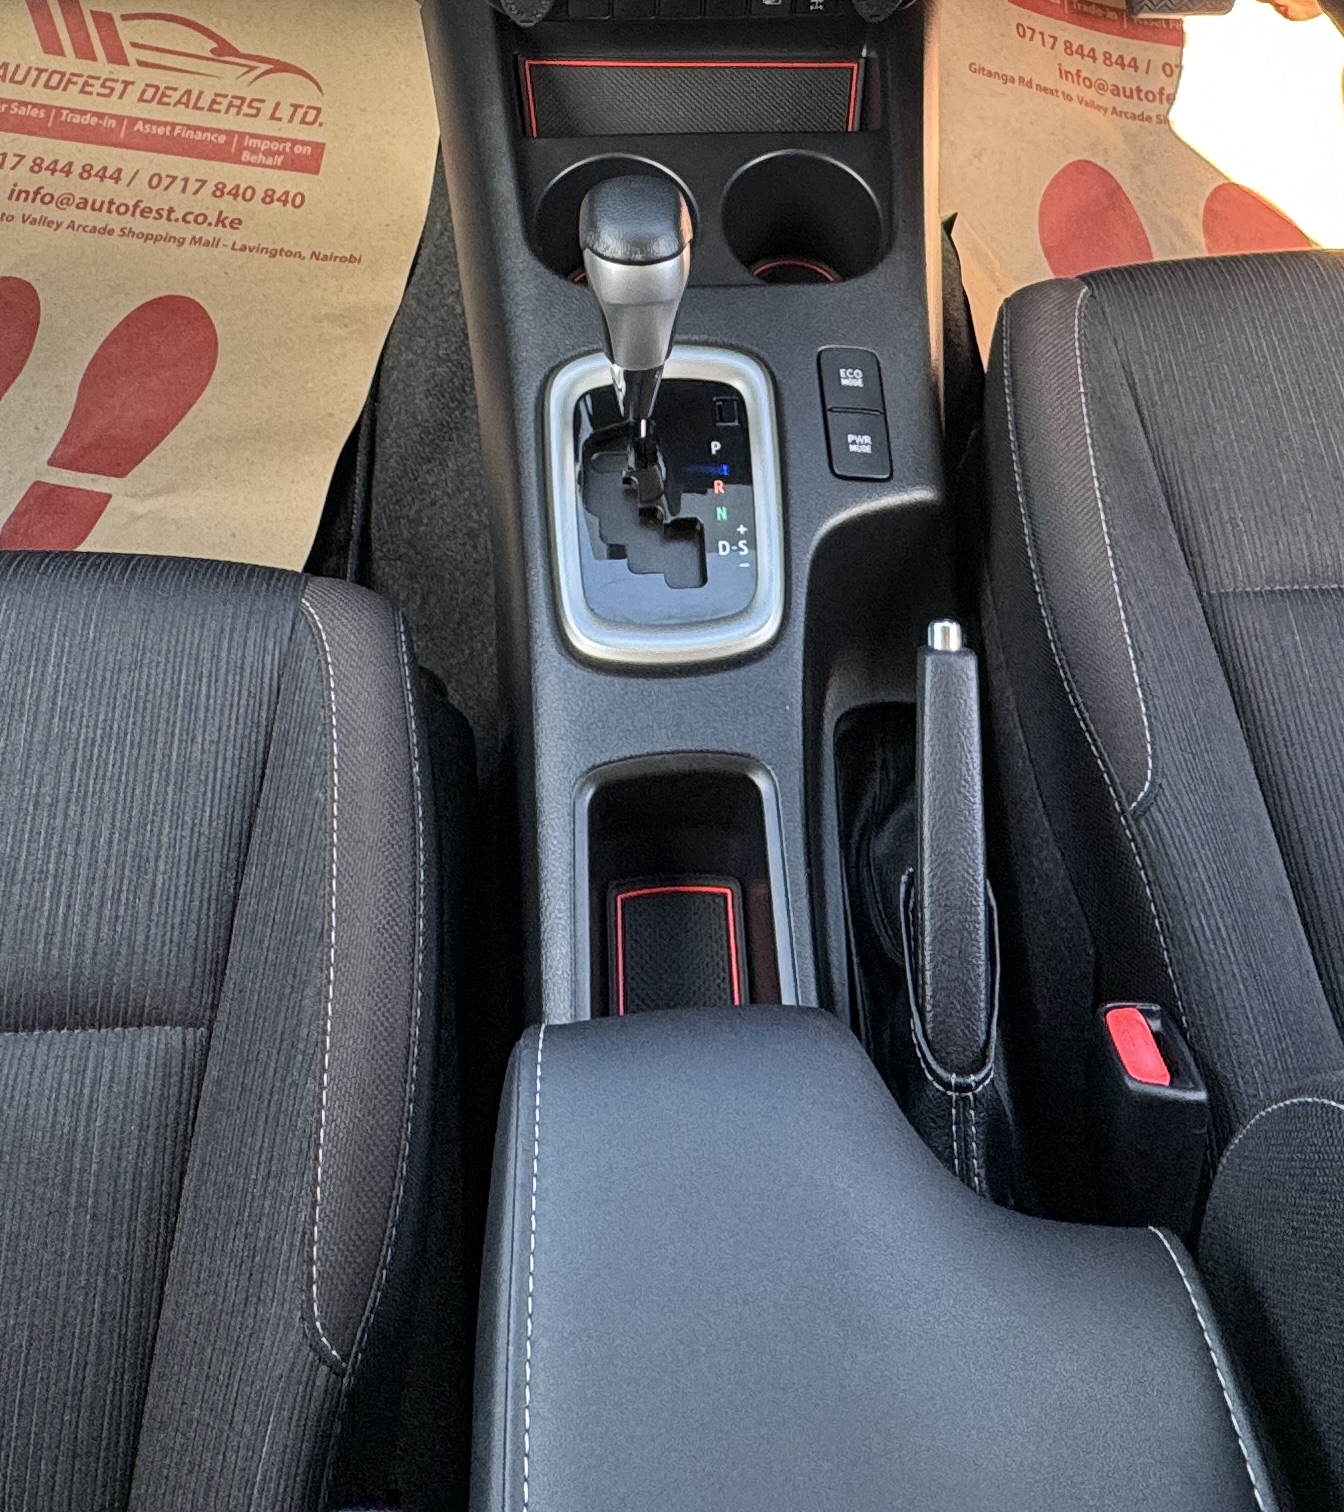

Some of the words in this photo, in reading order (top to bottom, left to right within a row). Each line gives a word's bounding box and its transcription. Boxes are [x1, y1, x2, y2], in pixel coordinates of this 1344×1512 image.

[1071, 0, 1119, 21] Trade-in
[1015, 22, 1058, 50] 0717
[1063, 39, 1098, 64] 844
[1102, 50, 1140, 73] 844
[968, 61, 1016, 85] Gitanga
[1018, 74, 1034, 89] Rd
[1035, 82, 1060, 99] next
[1061, 90, 1074, 103] to
[1076, 93, 1109, 116] Valley
[1110, 105, 1153, 124] Arcade
[1057, 62, 1175, 106] info@autofe
[9, 102, 46, 119] Sales
[137, 82, 266, 119] DEALERS
[268, 100, 324, 128] LTD.
[59, 109, 117, 129] Trade-in
[134, 120, 171, 137] Asset
[173, 126, 227, 144] Finance
[243, 136, 293, 154] Import
[293, 144, 312, 156] on
[240, 150, 286, 167] Behalf
[29, 156, 74, 178] 844
[78, 163, 123, 185] 844
[147, 172, 208, 196] 0717
[211, 181, 256, 203] 840
[260, 187, 306, 209] 840
[7, 182, 243, 231] info@autofest.co.ke
[0, 210, 15, 223] to
[20, 212, 64, 232] Valley
[65, 219, 115, 237] Arcade
[117, 226, 186, 248] Shopping
[188, 235, 221, 249] Mall
[230, 240, 306, 261] Lavington,
[309, 250, 363, 265] Nairobi
[839, 368, 863, 378] ECO
[710, 441, 722, 455] P
[847, 433, 872, 445] PWR
[713, 479, 725, 494] R
[716, 506, 728, 521] N
